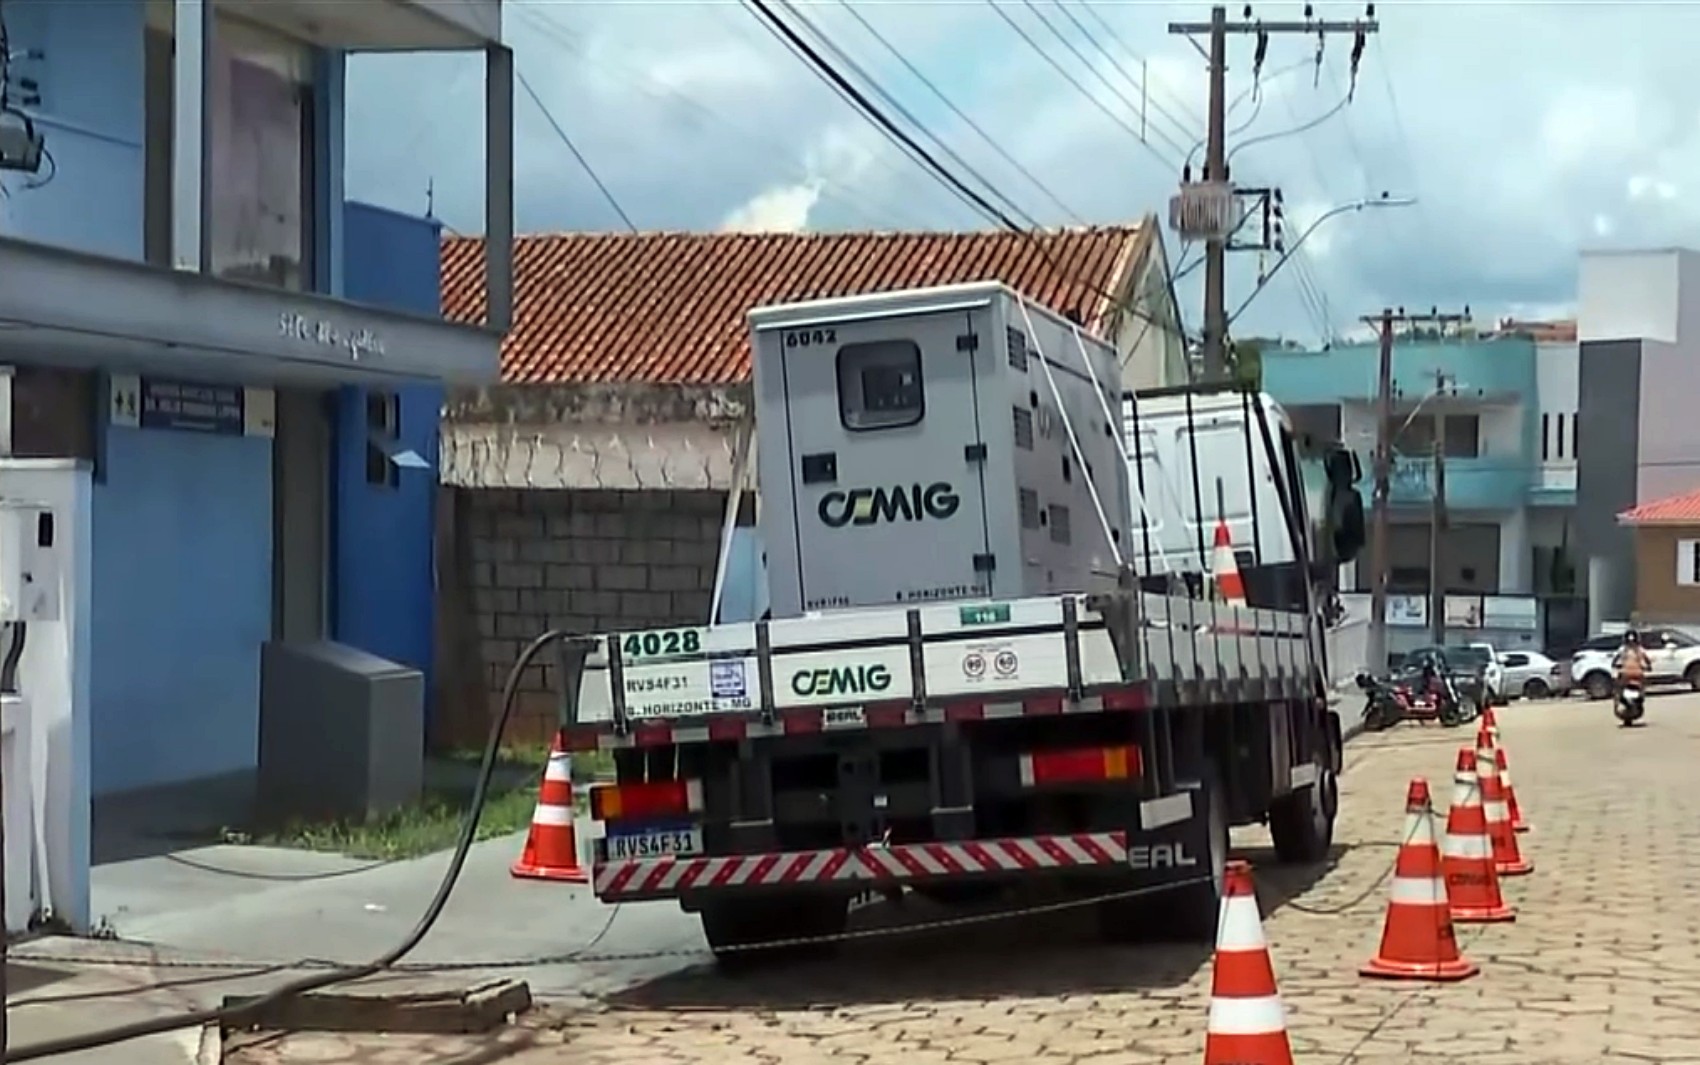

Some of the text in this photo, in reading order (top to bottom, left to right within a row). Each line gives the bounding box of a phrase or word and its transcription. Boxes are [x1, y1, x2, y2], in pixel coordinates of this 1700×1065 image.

[818, 482, 960, 527] CEMIG
[623, 630, 700, 656] 4028
[626, 676, 688, 692] RVS4F31
[791, 664, 891, 695] CEMIG
[616, 832, 692, 857] RVS4F31
